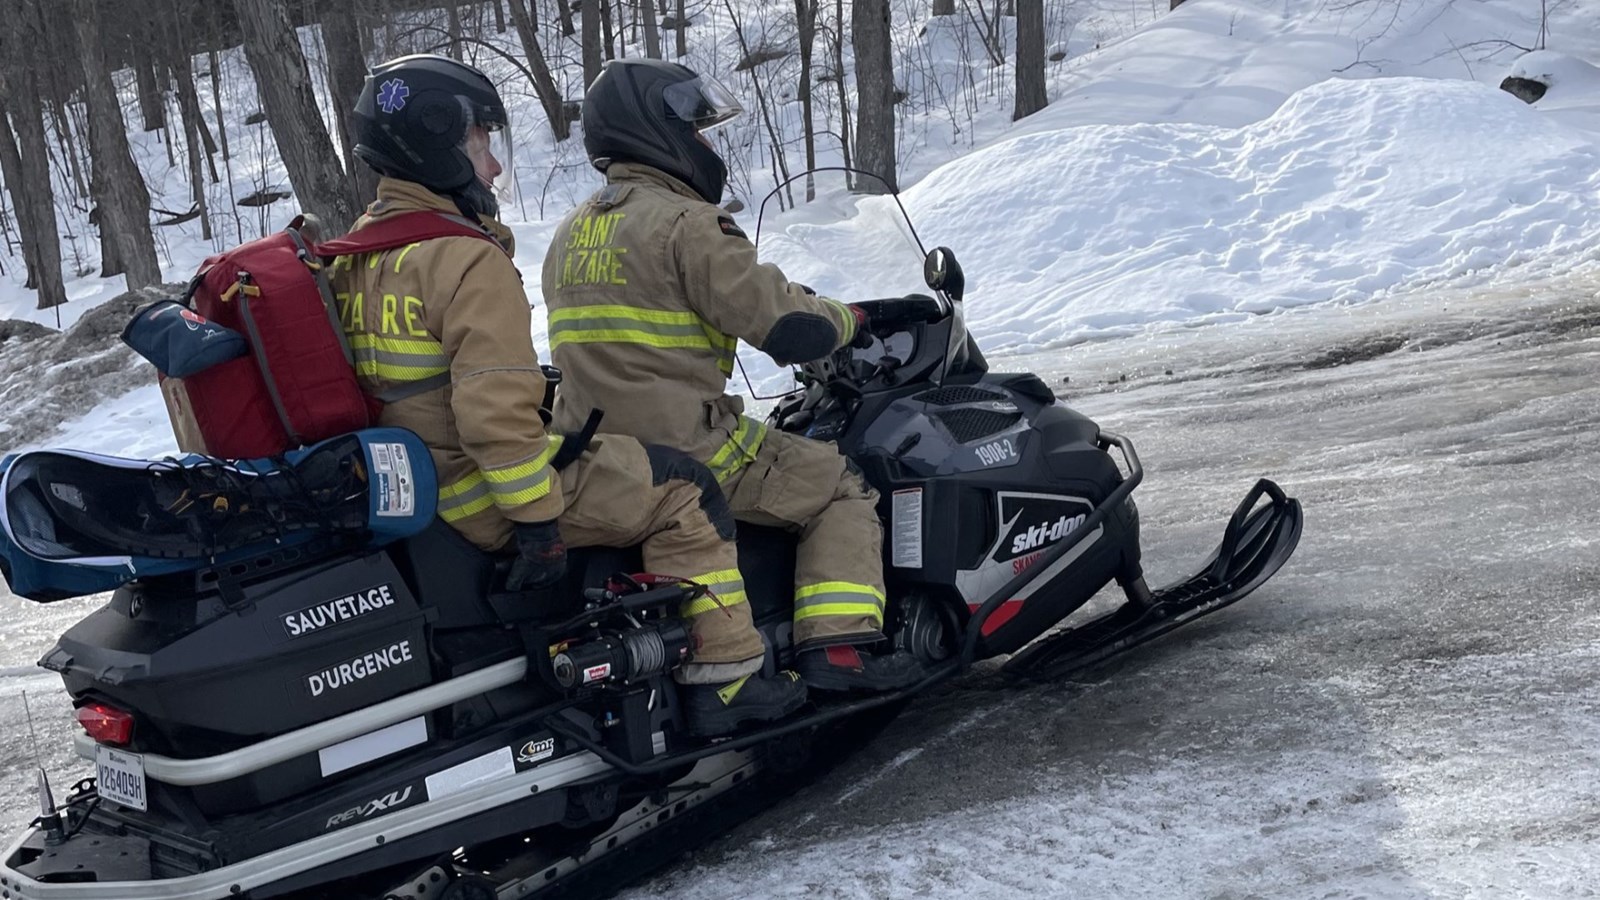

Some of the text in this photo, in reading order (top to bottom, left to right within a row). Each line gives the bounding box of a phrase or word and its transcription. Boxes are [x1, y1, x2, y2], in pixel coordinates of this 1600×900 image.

[565, 213, 626, 249] SAINT
[336, 292, 428, 337] ZARE
[285, 585, 395, 635] SAUVETAGE
[308, 640, 412, 697] D'URGENCE
